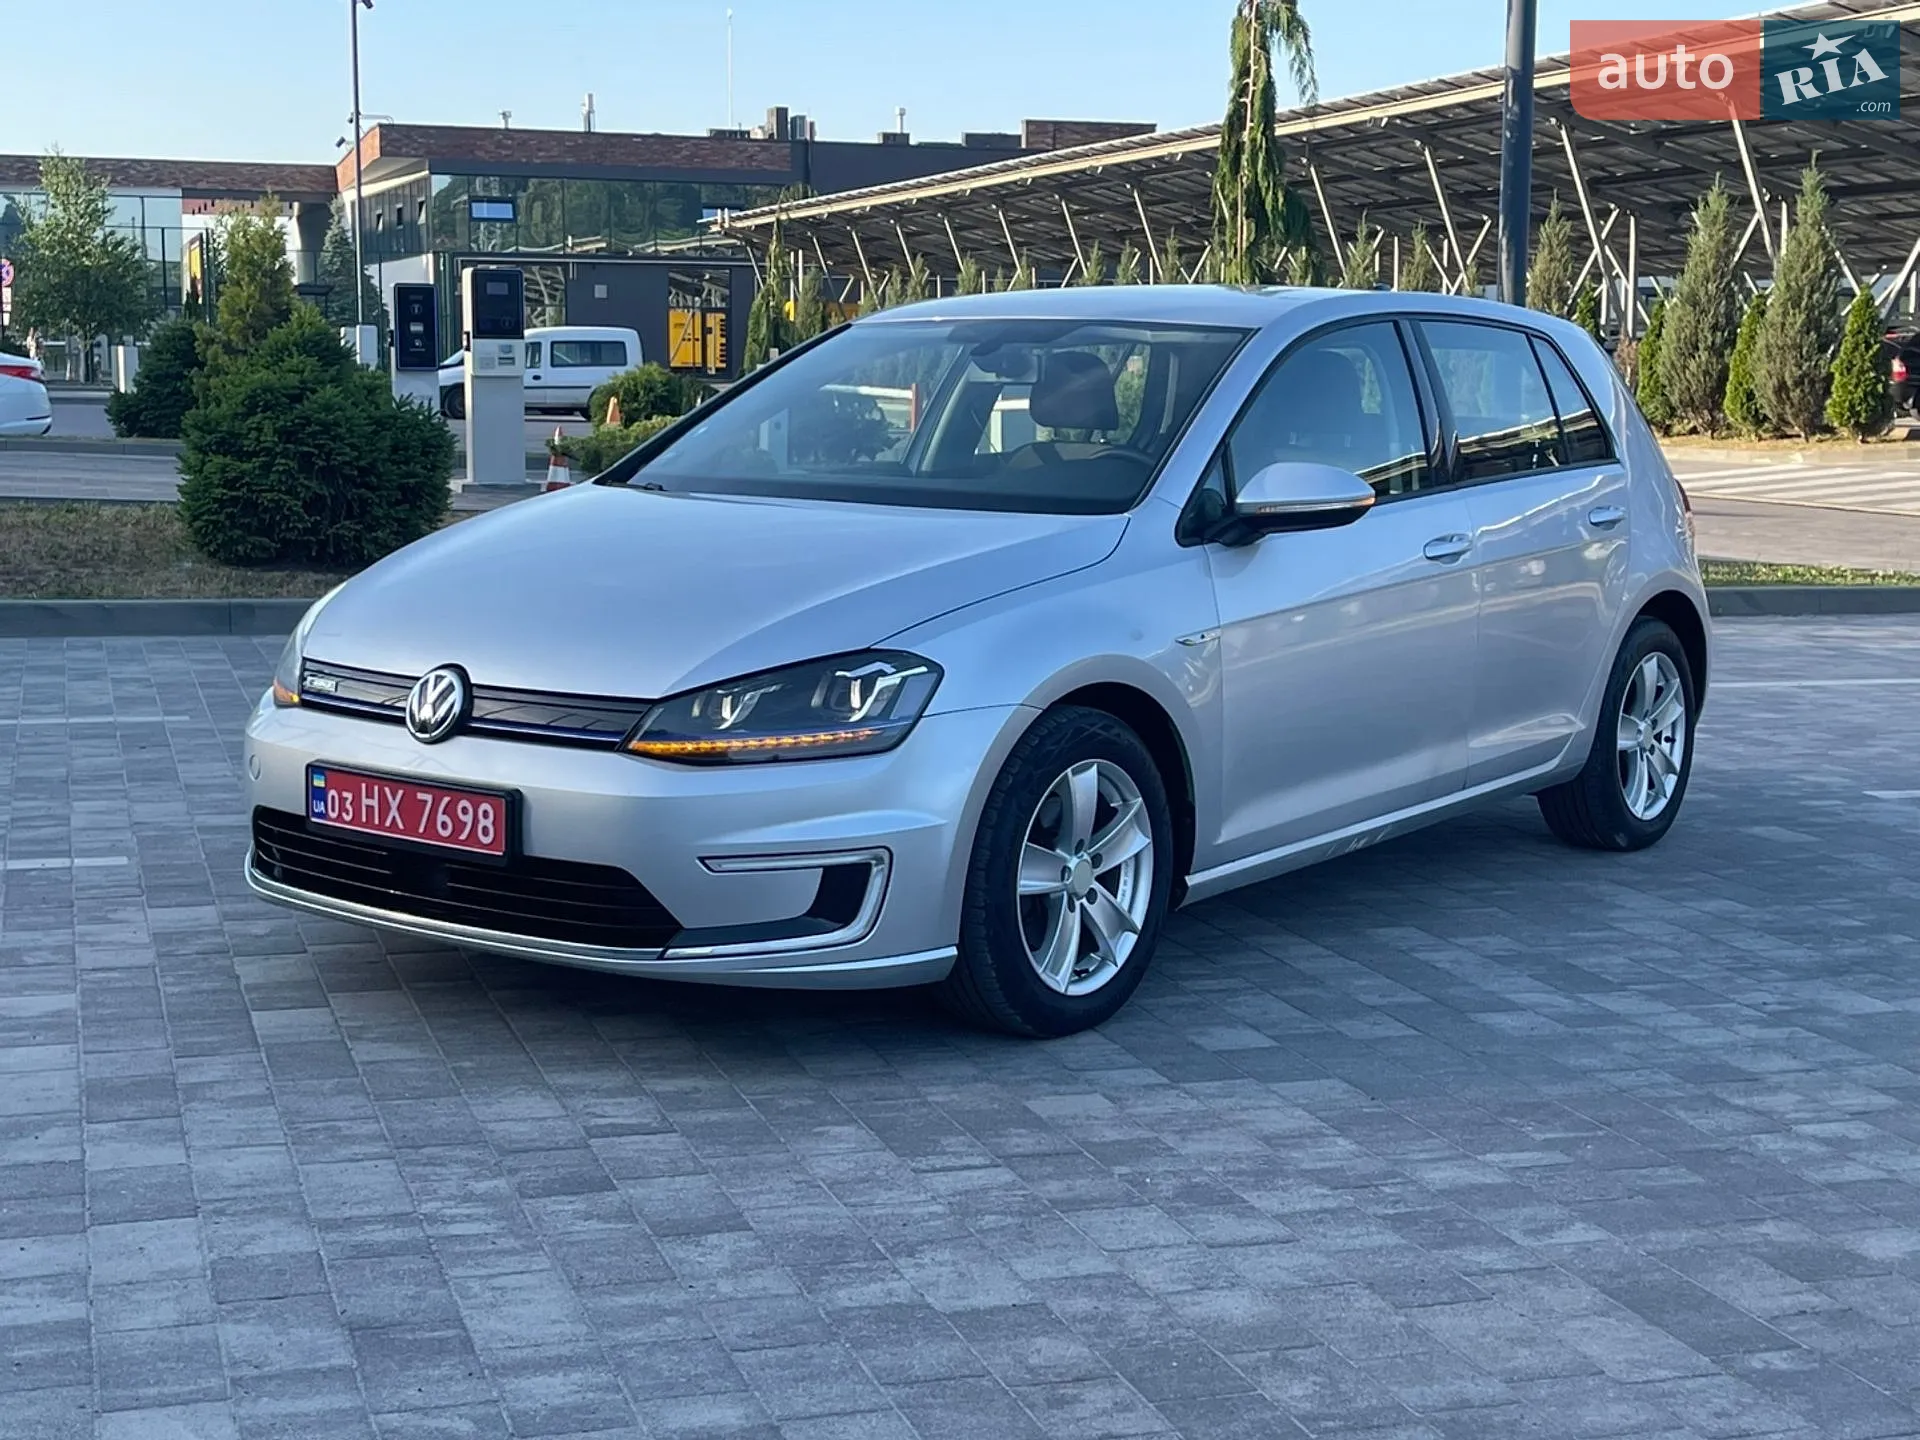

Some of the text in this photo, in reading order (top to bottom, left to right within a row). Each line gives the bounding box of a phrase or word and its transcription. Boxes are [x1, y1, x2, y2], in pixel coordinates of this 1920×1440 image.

[313, 783, 495, 845] UA 03 HX 7698
